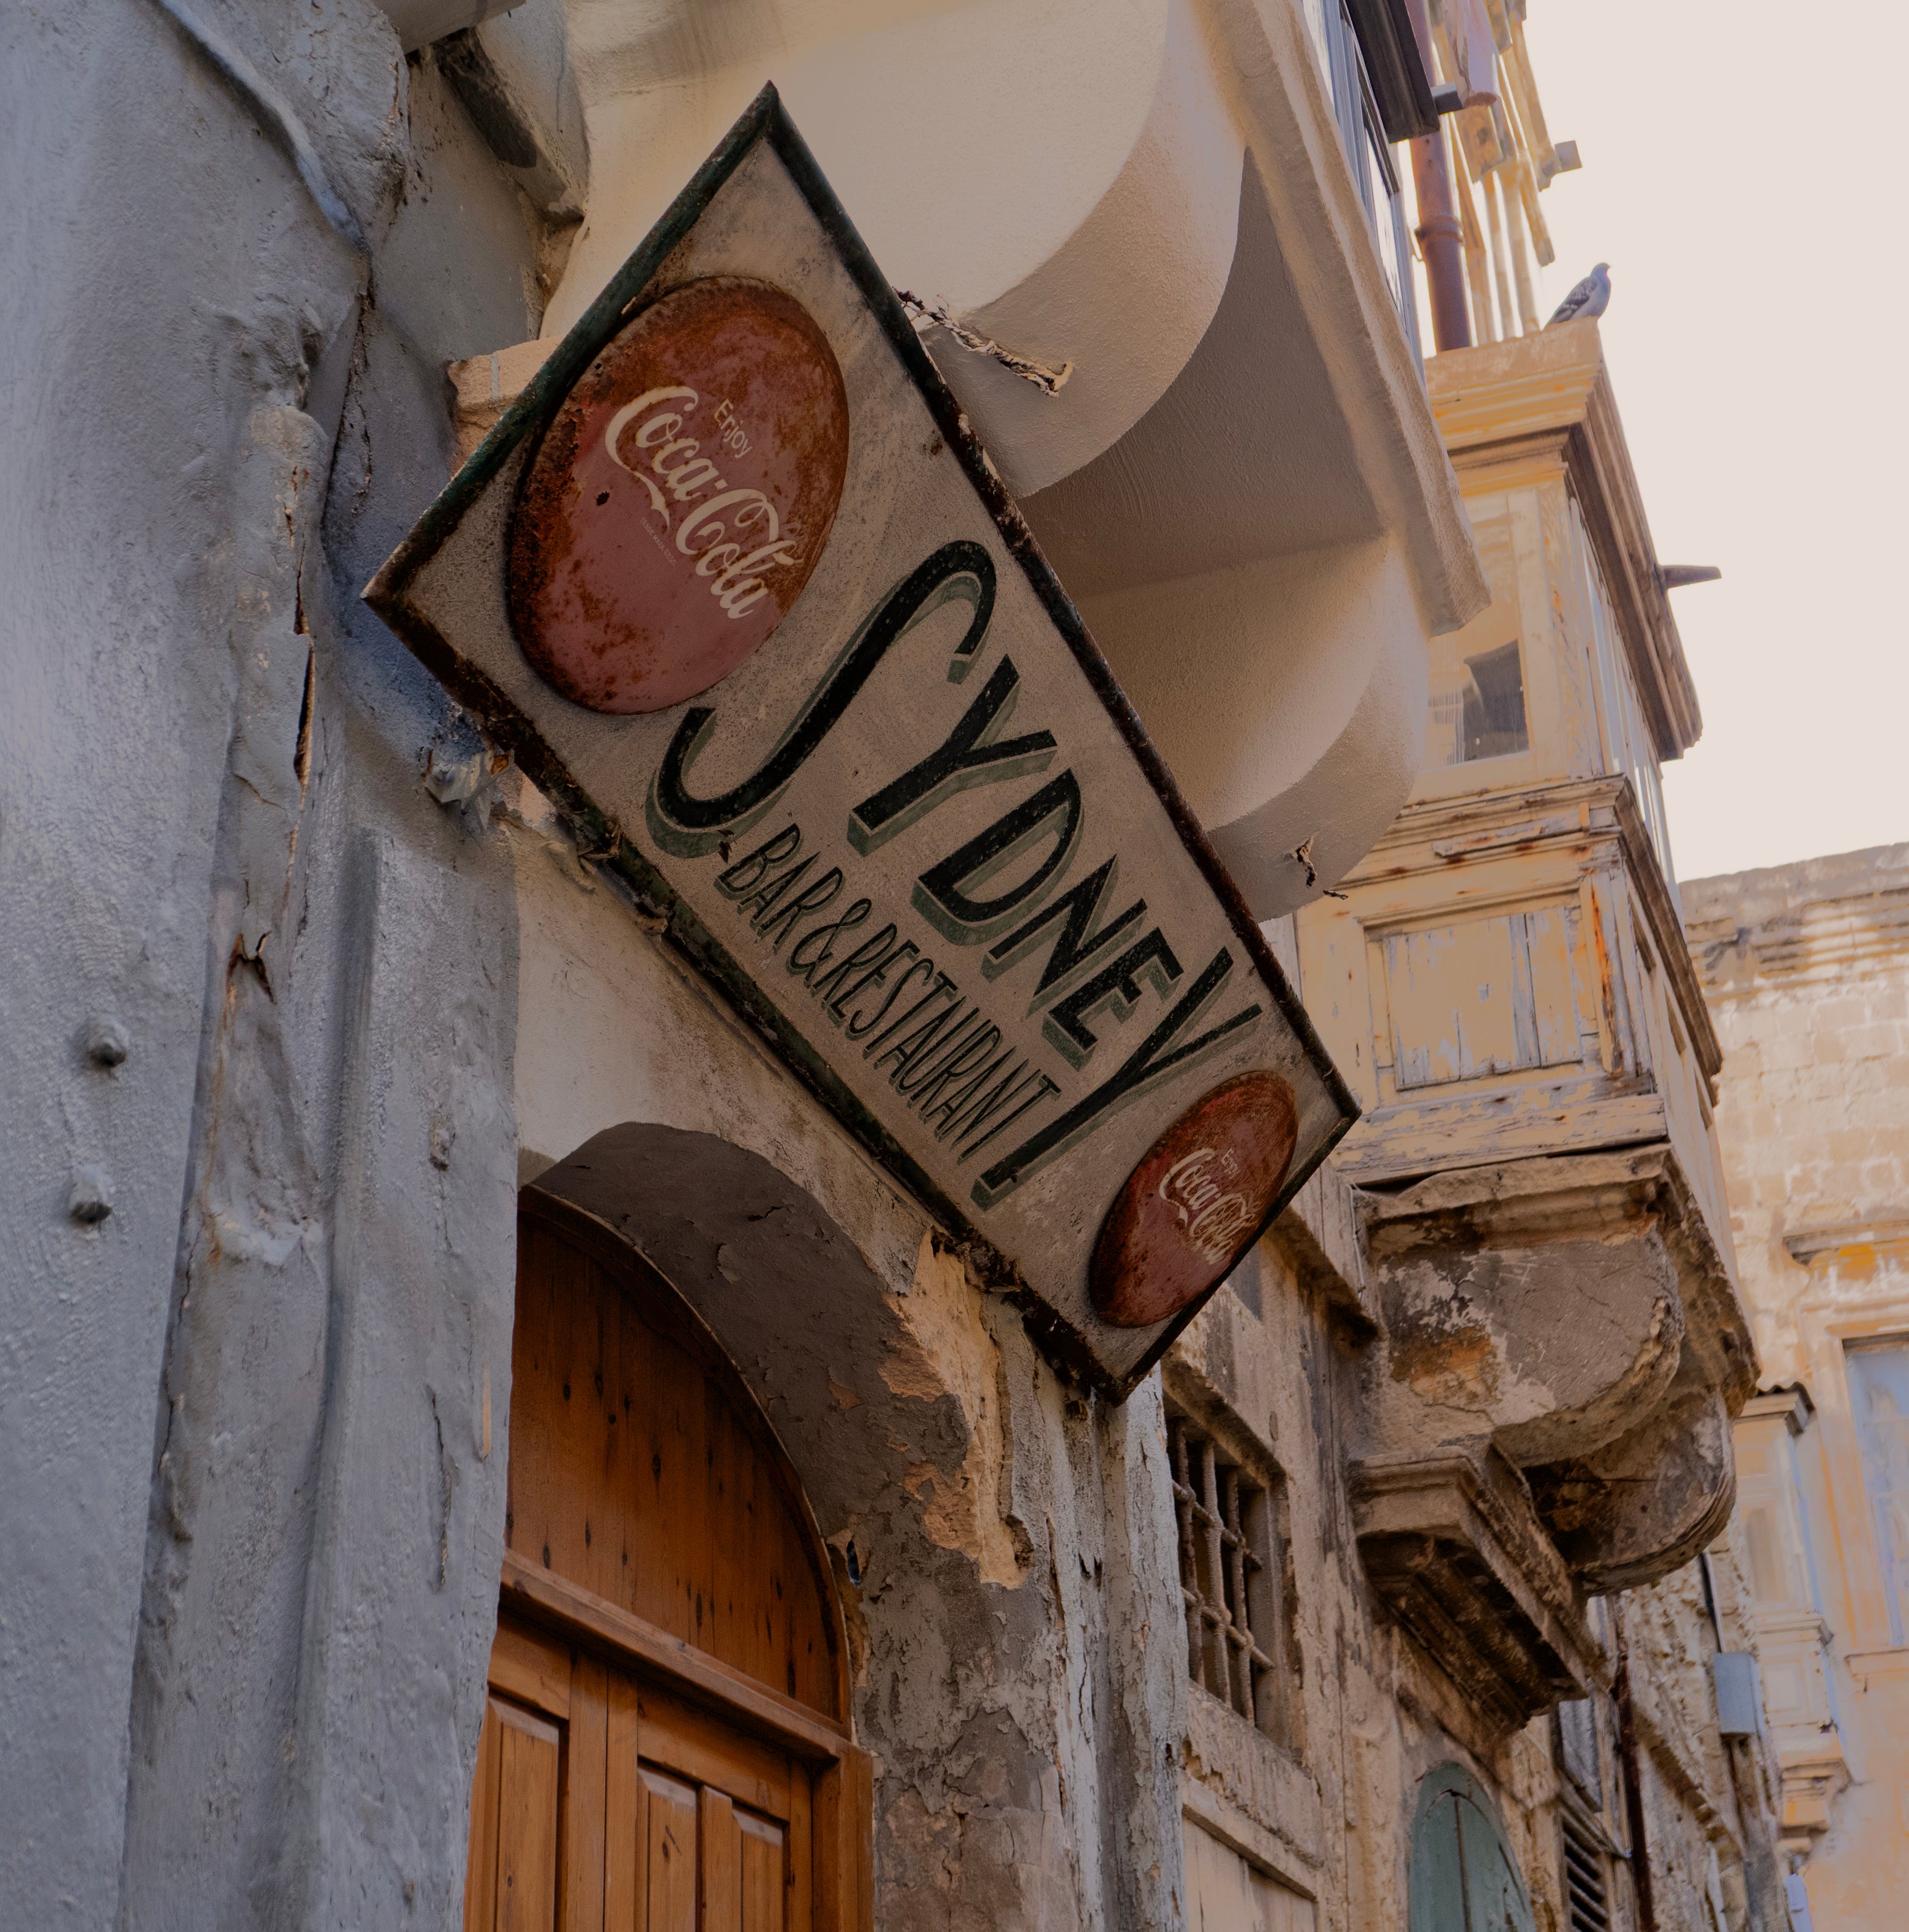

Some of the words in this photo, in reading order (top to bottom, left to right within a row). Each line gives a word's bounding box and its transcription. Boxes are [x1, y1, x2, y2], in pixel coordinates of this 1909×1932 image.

[712, 398, 753, 459] Enjoy
[605, 385, 799, 620] Coca-Cola
[640, 517, 654, 536] TRADE
[653, 534, 665, 552] MARK
[647, 540, 1262, 1211] SYDNEY
[715, 823, 845, 952] BAR
[789, 897, 871, 977] &
[805, 922, 1062, 1164] RESTAURANT
[1159, 1147, 1255, 1265] Coca-Cola
[1220, 1147, 1241, 1180] Enjoy
